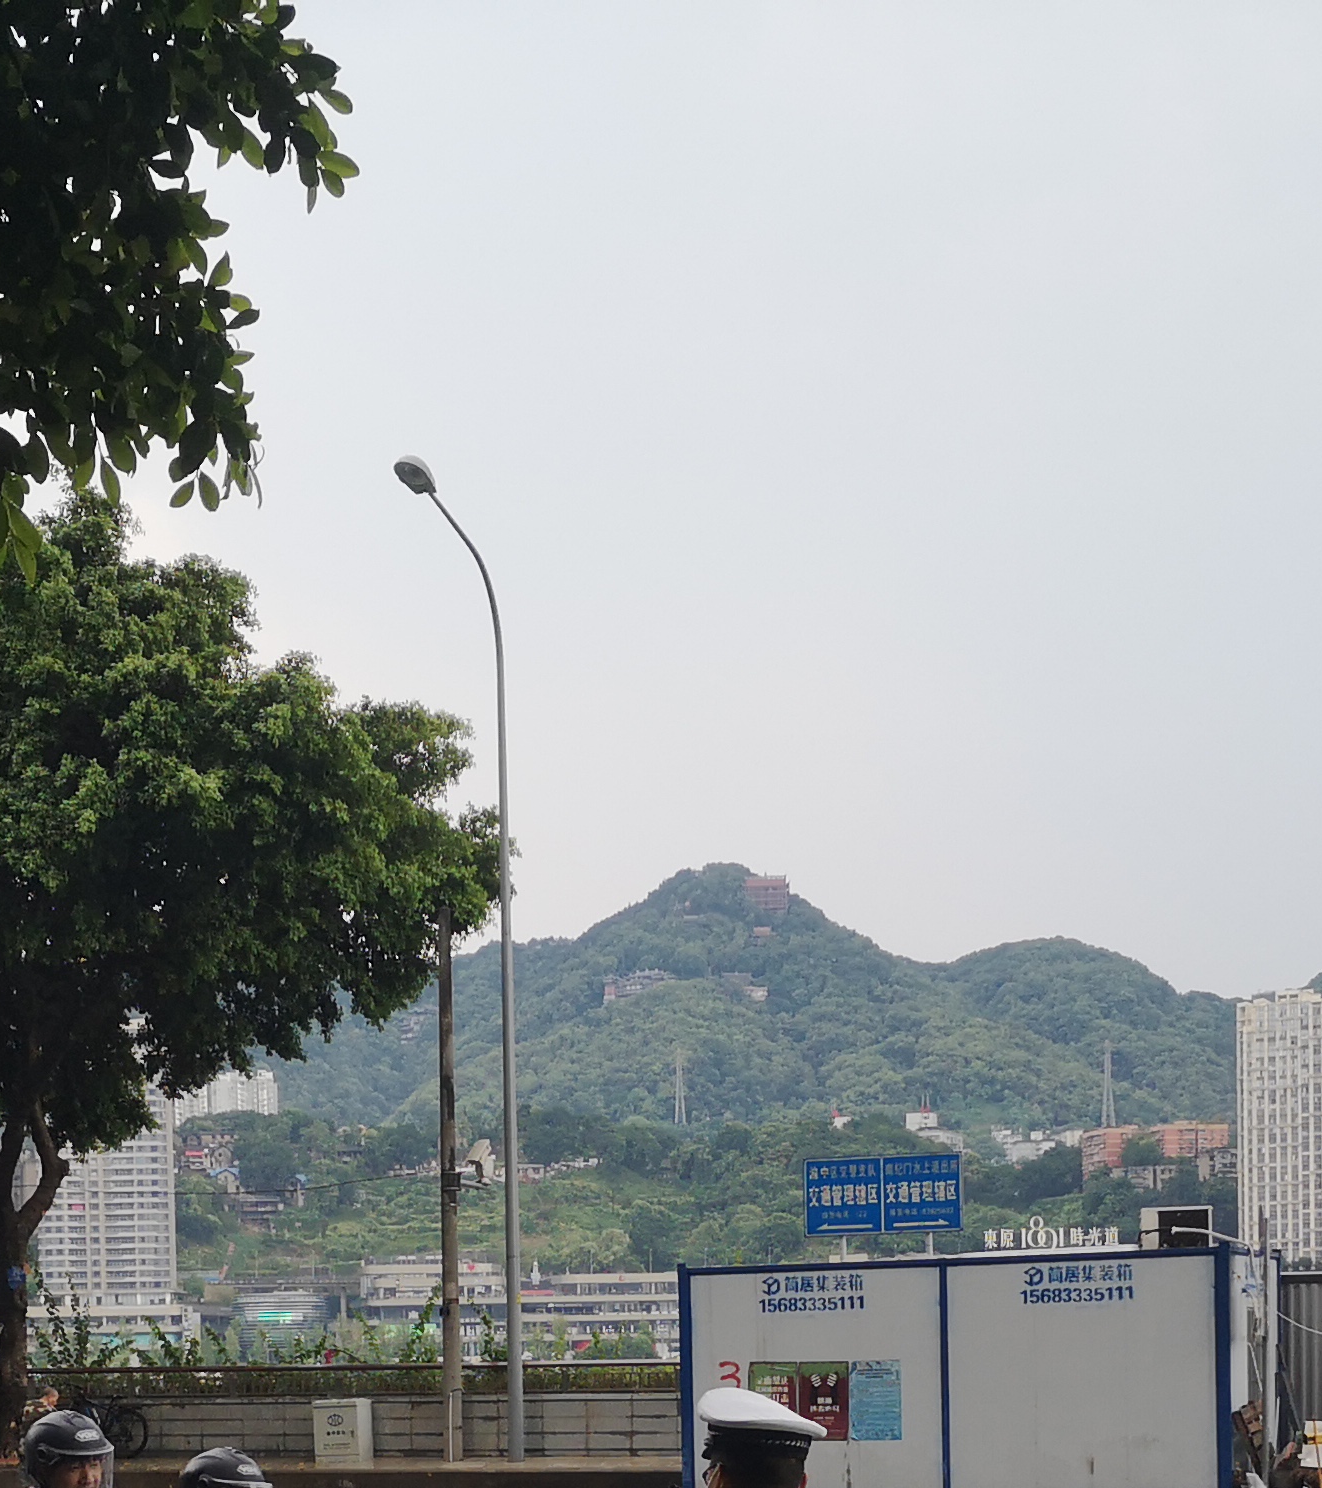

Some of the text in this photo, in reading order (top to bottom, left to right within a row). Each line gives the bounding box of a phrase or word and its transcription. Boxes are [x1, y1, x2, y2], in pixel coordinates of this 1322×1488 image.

[809, 1182, 878, 1208] 交通管理辖区
[886, 1179, 957, 1203] 交通管理辖区
[759, 1295, 864, 1313] 15683335111
[1020, 1286, 1134, 1304] 15683335111
